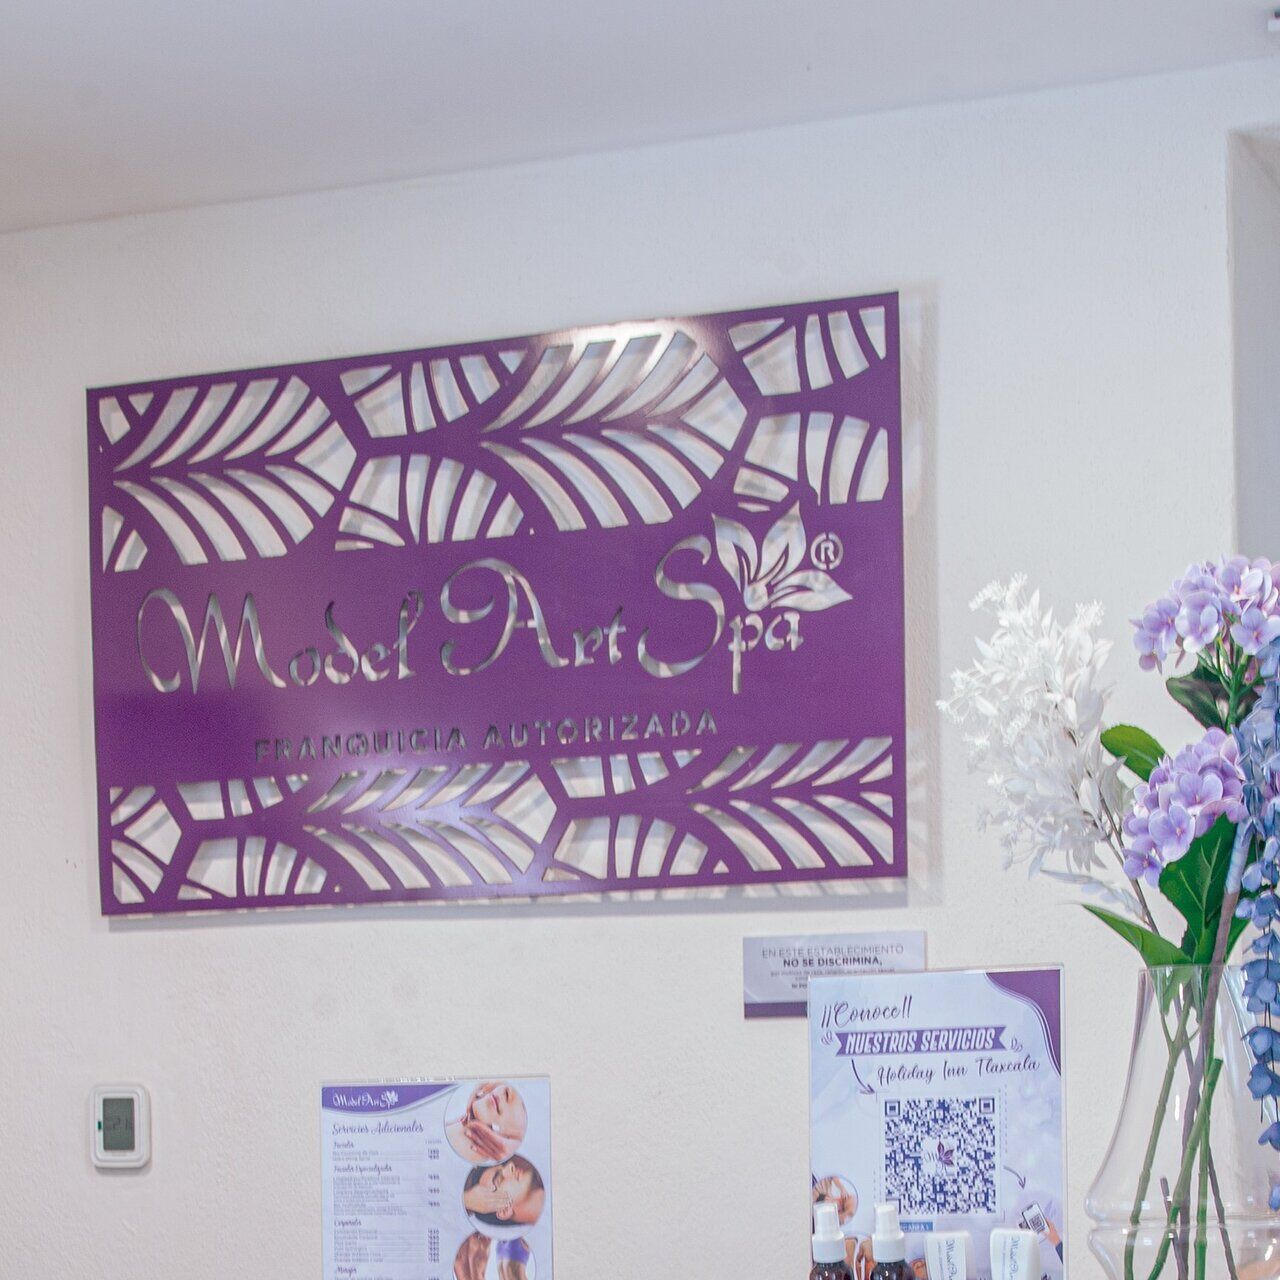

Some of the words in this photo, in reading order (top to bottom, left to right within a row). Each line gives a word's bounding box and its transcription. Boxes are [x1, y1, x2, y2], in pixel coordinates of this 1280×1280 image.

[136, 587, 425, 695] Model
[439, 557, 627, 677] Art
[636, 534, 804, 696] Spa
[254, 726, 468, 763] FRANQUICIA
[482, 707, 718, 752] AUTORIZADA
[762, 945, 777, 960] EN
[778, 945, 805, 959] ESTE
[806, 942, 905, 957] ESTABLECIMIENTO
[782, 958, 799, 968] NO
[801, 957, 815, 967] SE
[817, 956, 883, 967] DISCRIMINA,
[844, 1031, 918, 1055] NUESTROS
[920, 1028, 996, 1051] SERVICIOS
[876, 1063, 936, 1087] Holiday
[942, 1059, 969, 1080] Inn
[975, 1053, 1041, 1078] Tlaxcala
[331, 1122, 369, 1135] Servicios
[370, 1118, 424, 1135] Adicionales
